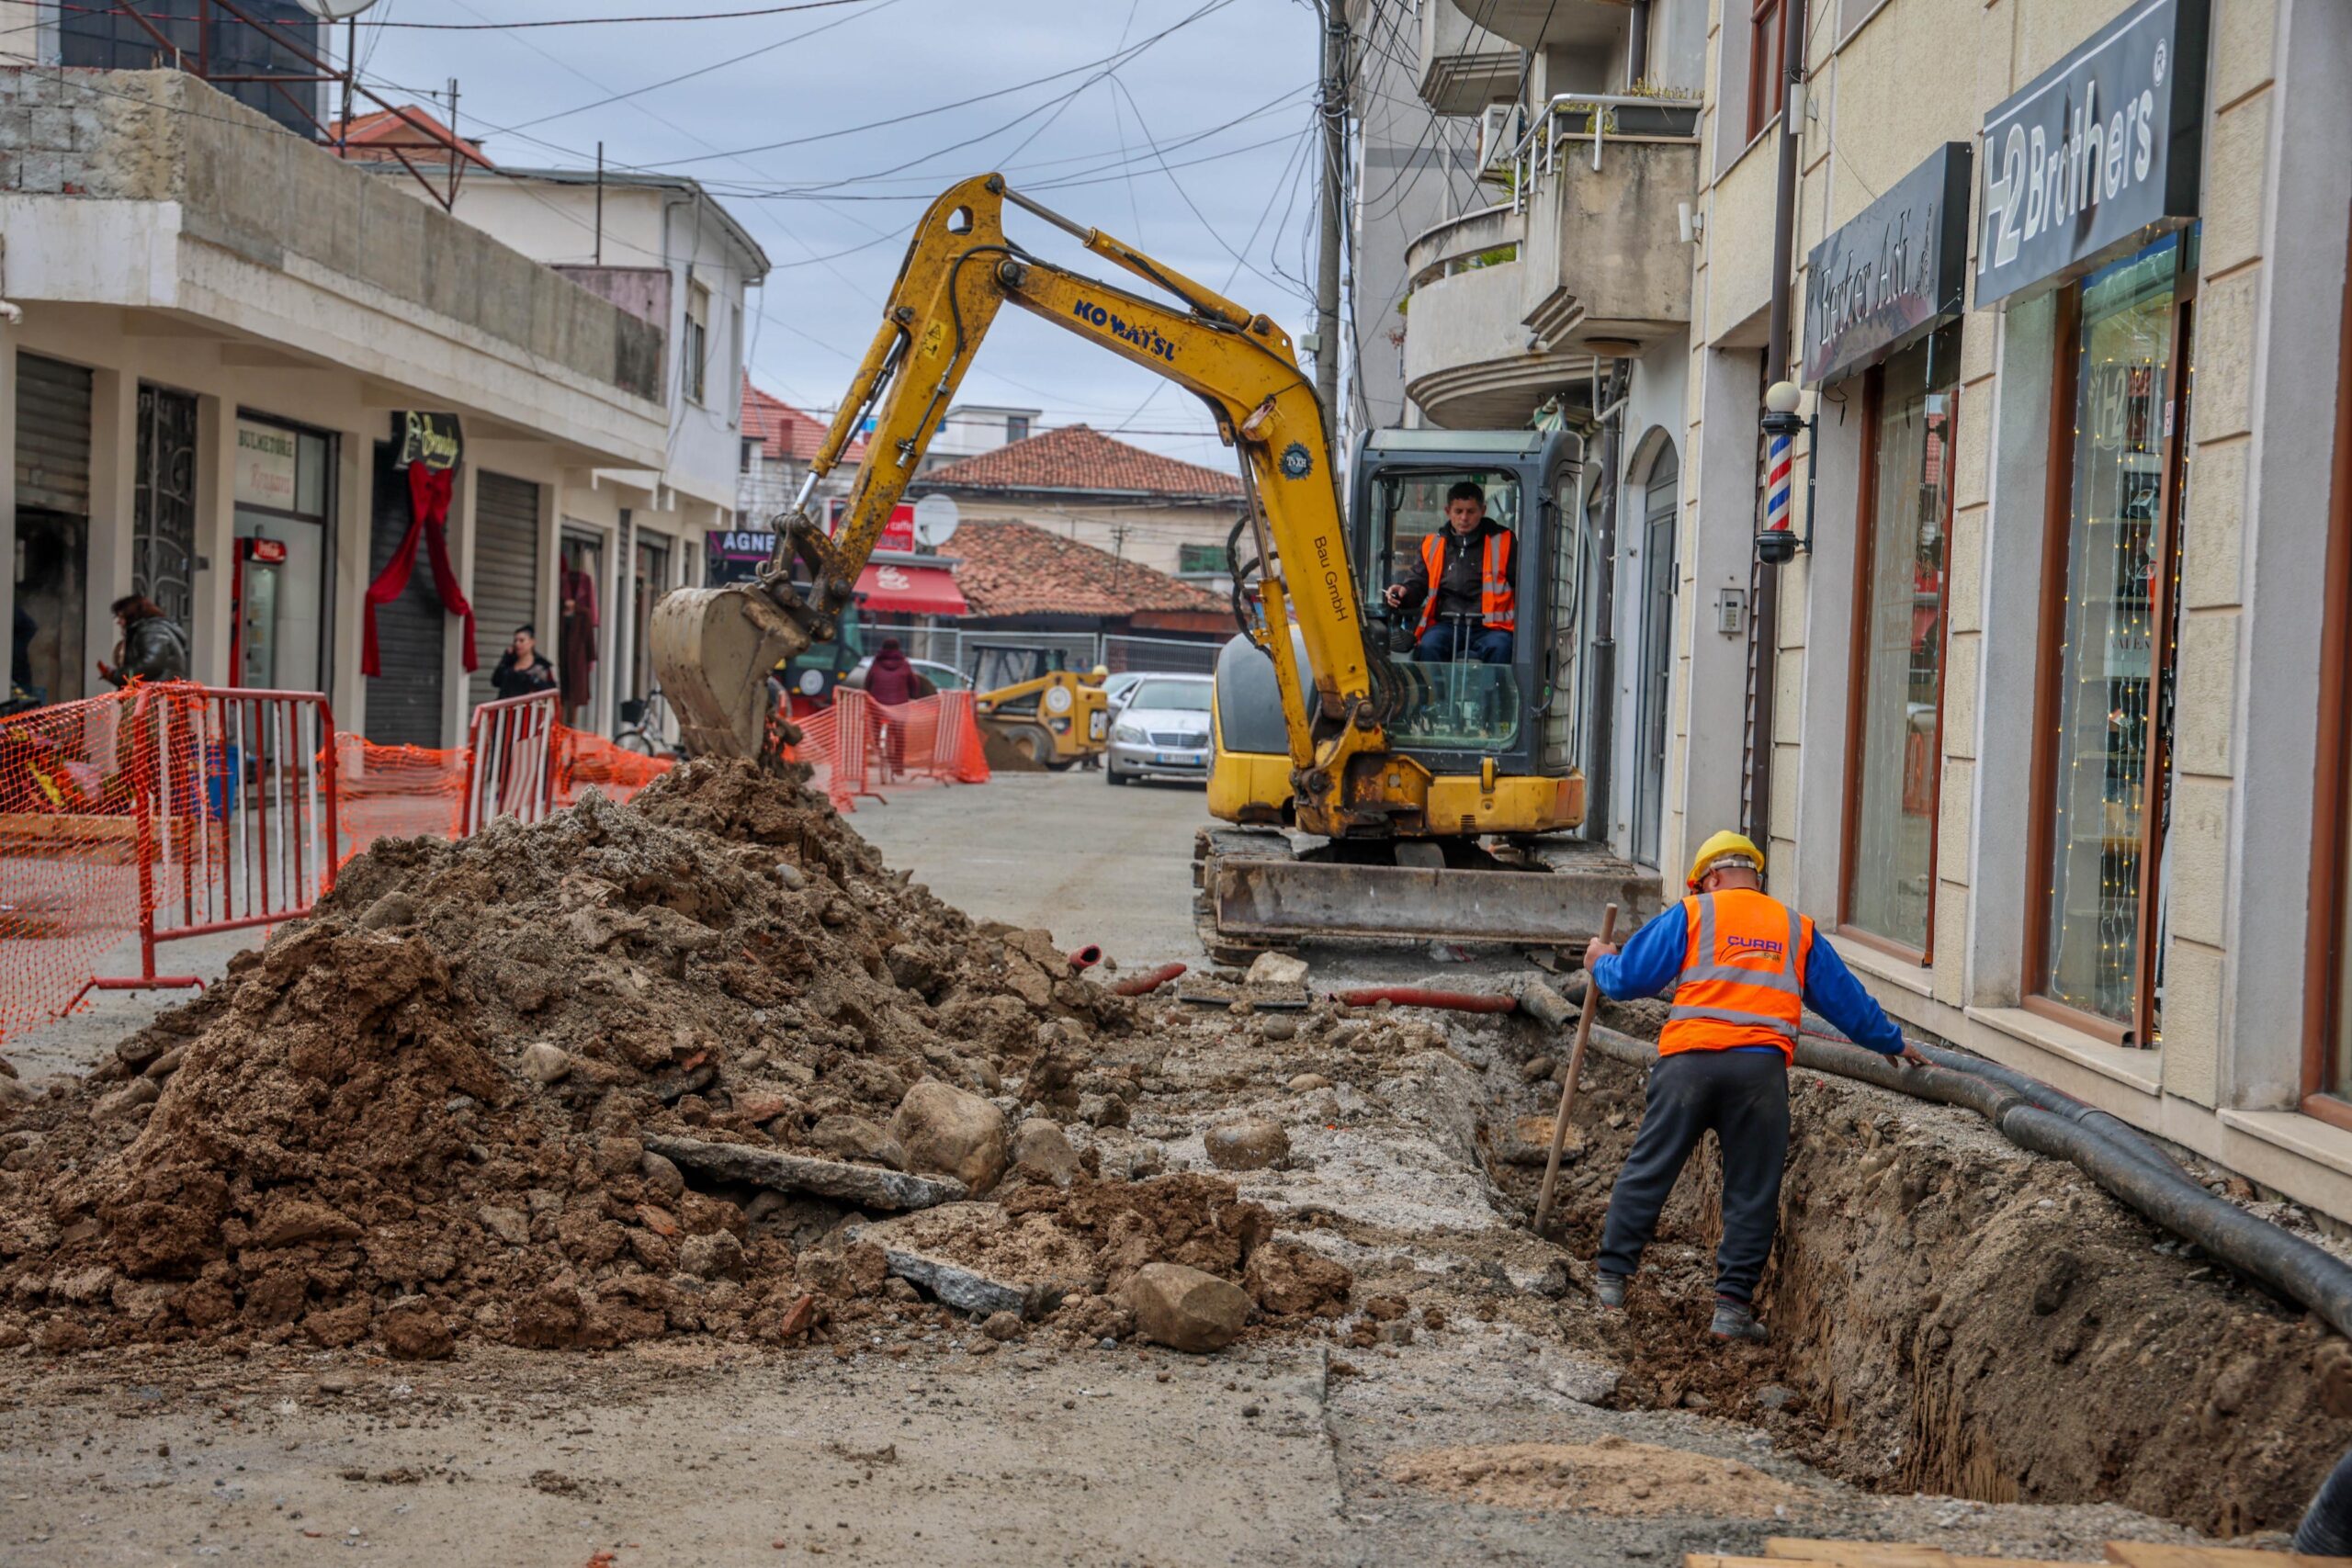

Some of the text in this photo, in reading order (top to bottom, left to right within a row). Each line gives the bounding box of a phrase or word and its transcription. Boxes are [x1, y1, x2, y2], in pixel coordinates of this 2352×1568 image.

[1315, 536, 1349, 622] Bau GmbH
[1727, 935, 1782, 952] CURRI
